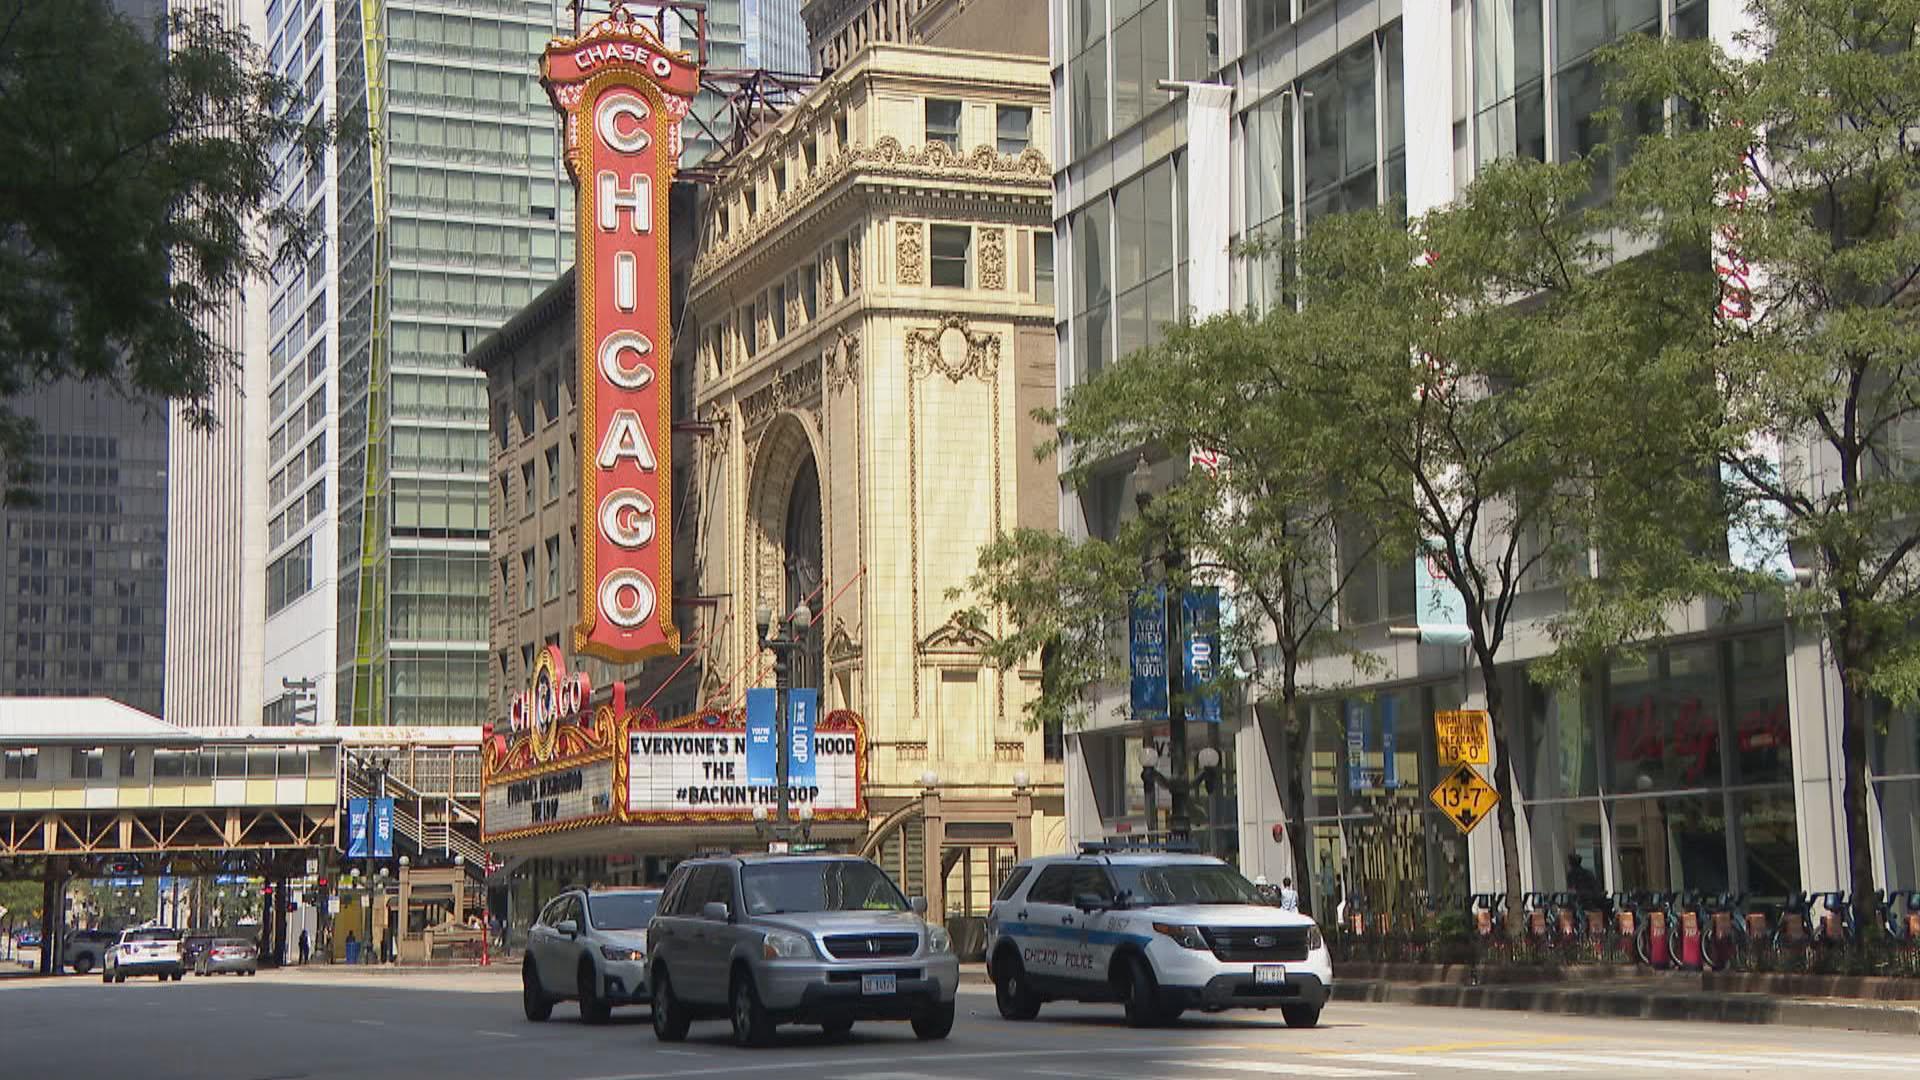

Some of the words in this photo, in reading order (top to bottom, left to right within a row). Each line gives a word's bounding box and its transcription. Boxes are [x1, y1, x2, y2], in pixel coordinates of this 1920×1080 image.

[575, 44, 649, 69] CHASE
[595, 93, 658, 630] CHICAGO
[630, 735, 729, 756] EVERYONE'S
[753, 735, 769, 743] BACK
[792, 725, 808, 763] LOOP
[1440, 735, 1485, 745] CLEARANCE
[702, 761, 736, 781] THE
[676, 784, 819, 804] #BACKINTHEOOP
[1023, 947, 1058, 966] CHICAGO
[1065, 951, 1094, 970] POLICE
